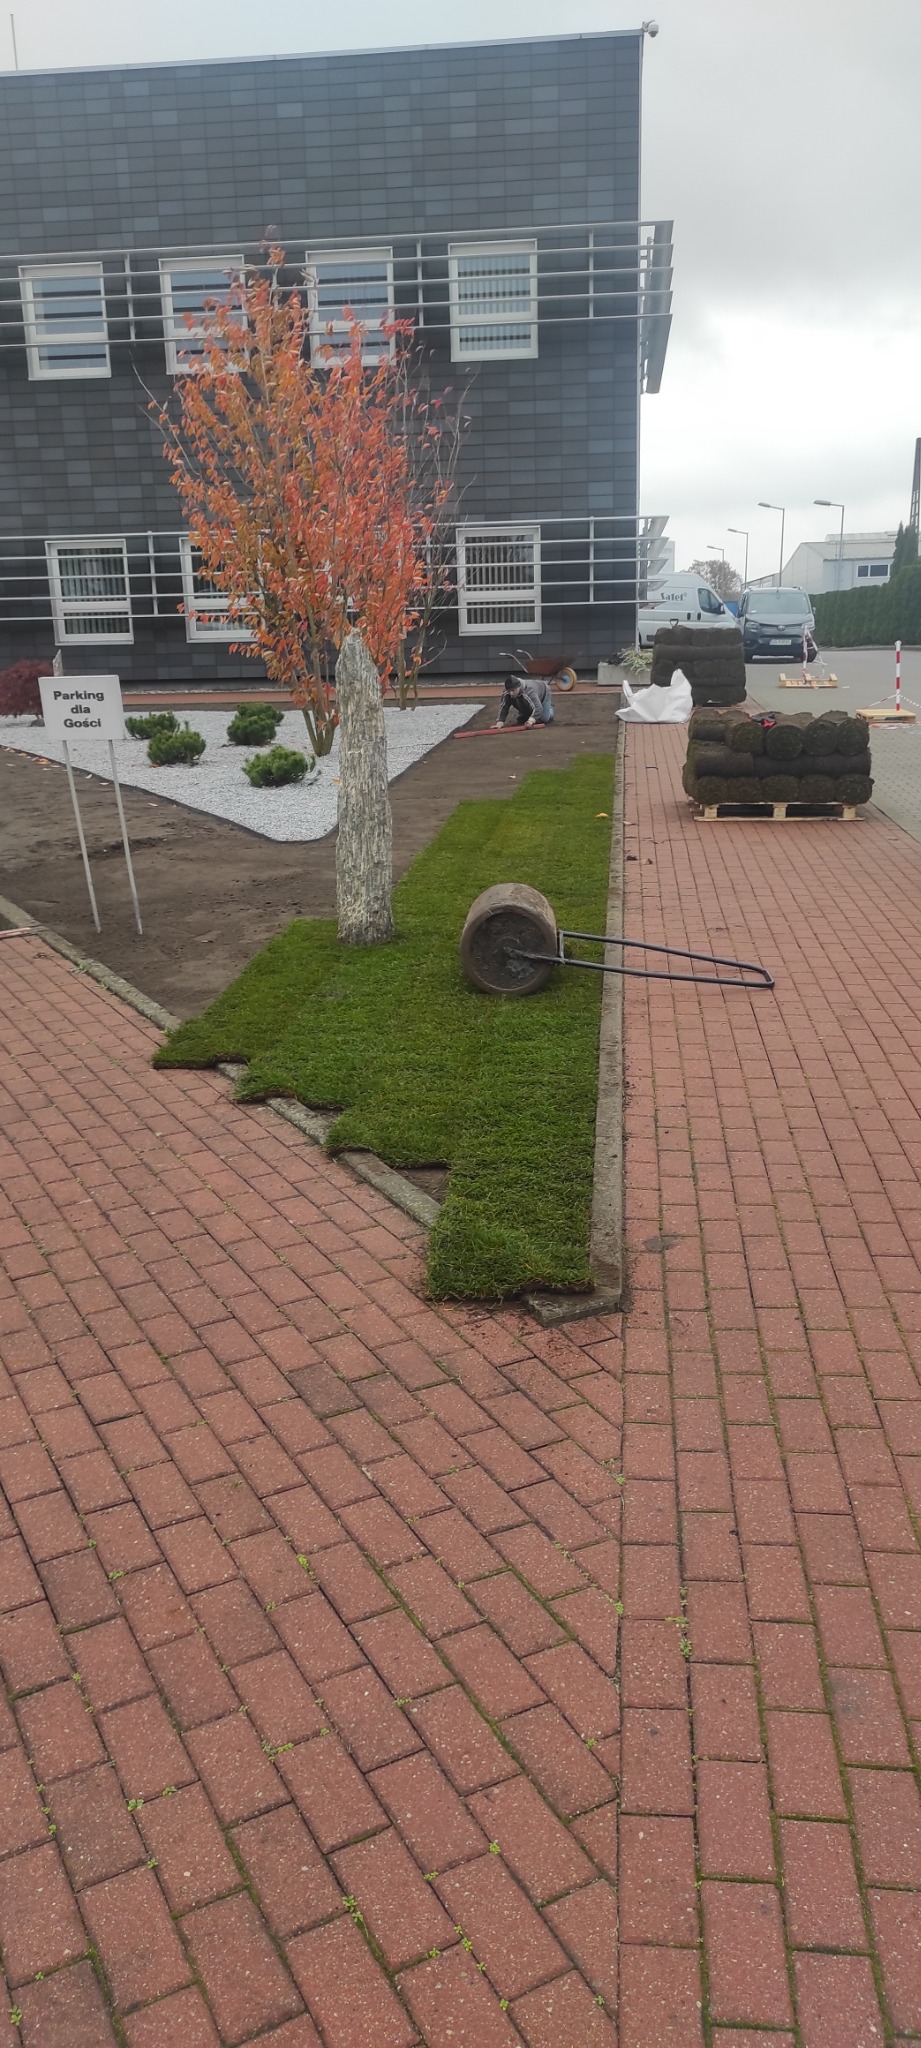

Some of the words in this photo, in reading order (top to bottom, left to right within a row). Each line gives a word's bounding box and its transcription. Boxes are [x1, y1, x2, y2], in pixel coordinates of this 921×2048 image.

[53, 690, 104, 702] Parking
[70, 704, 91, 714] dla
[63, 718, 102, 728] Gości
